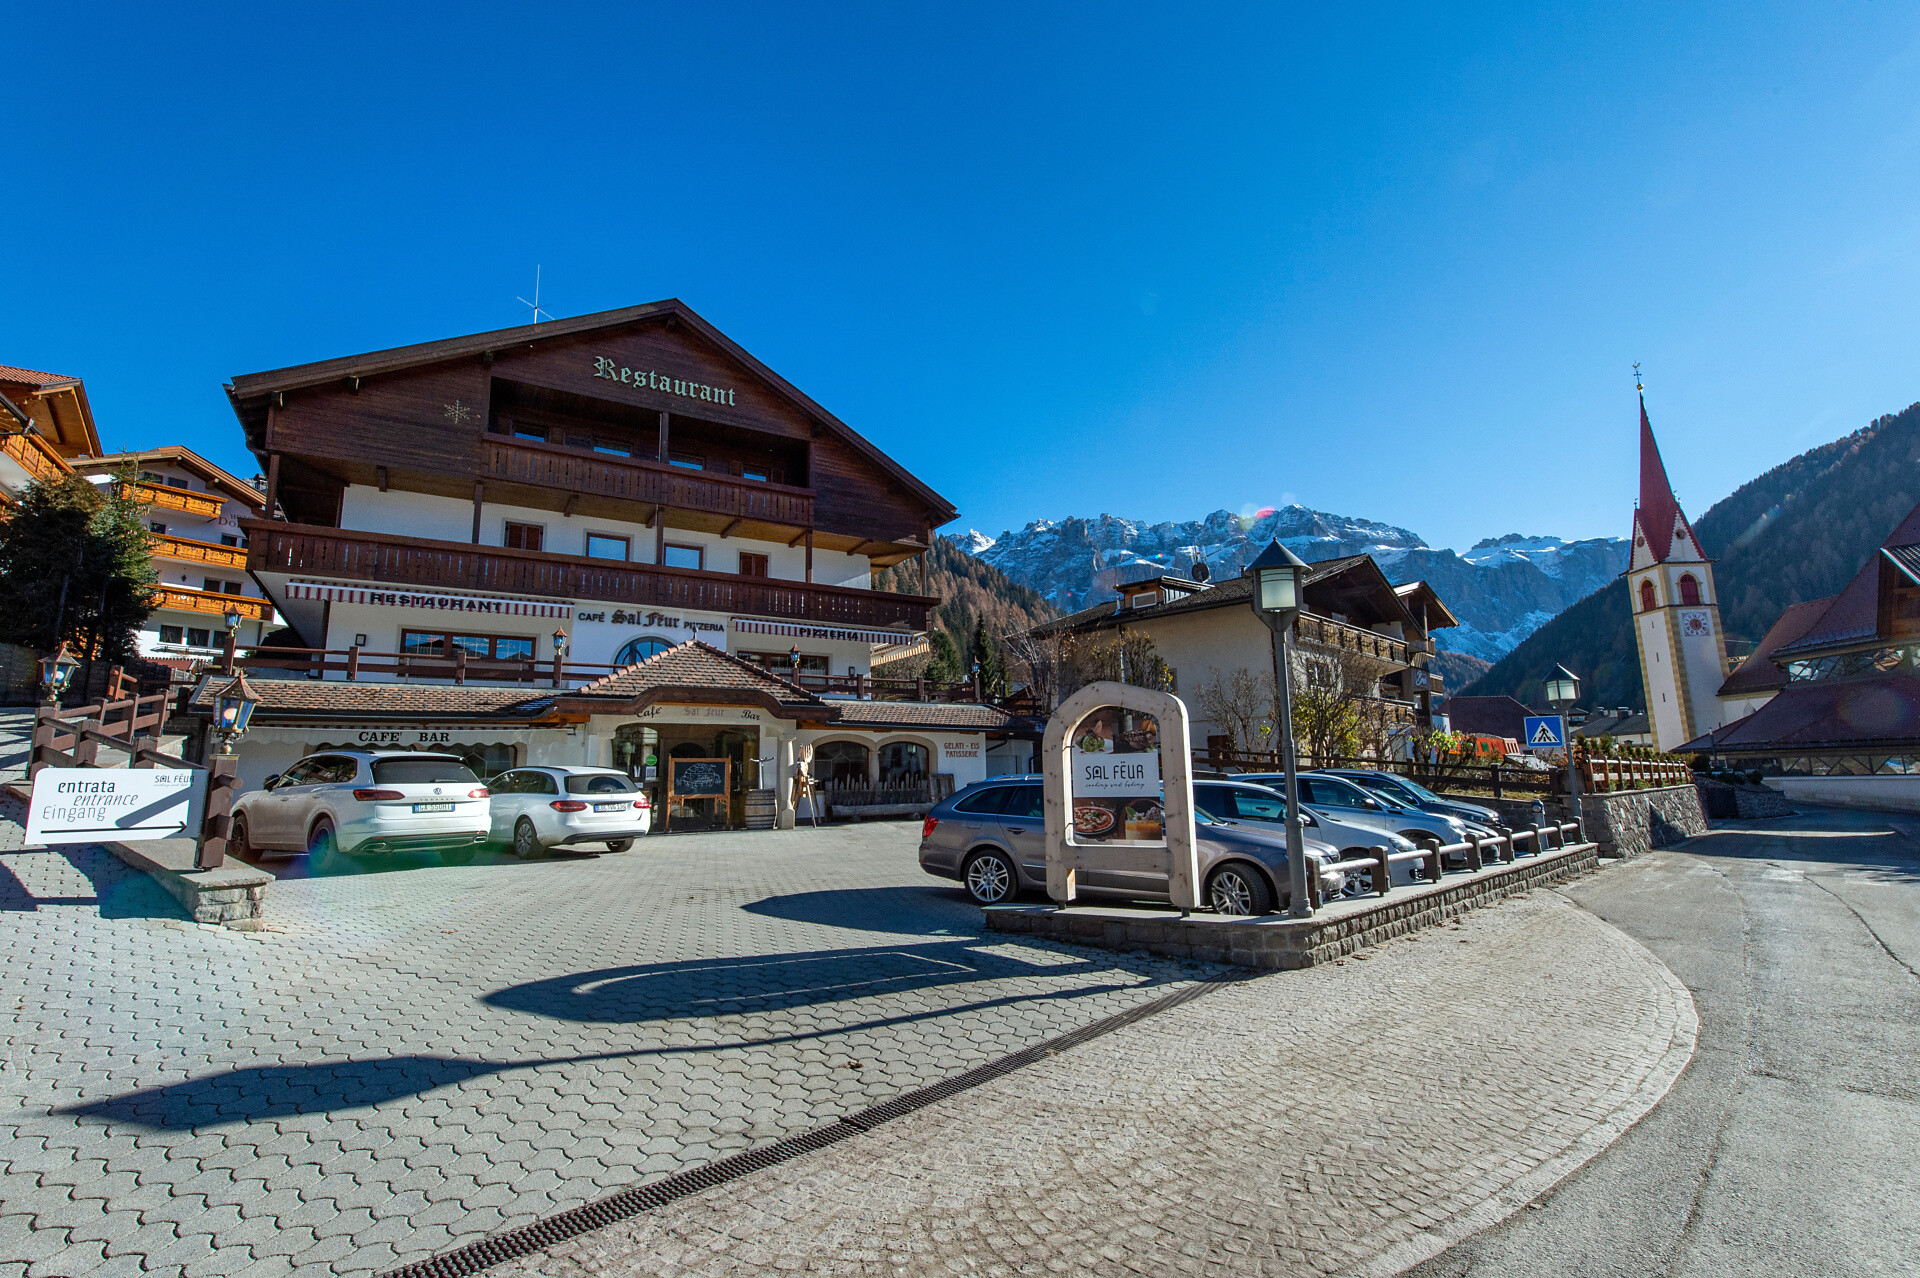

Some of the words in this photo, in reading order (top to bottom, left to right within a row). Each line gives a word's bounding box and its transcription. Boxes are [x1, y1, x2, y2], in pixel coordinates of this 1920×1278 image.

[593, 355, 736, 407] Restaurant
[370, 592, 502, 611] RESTAURANT
[611, 608, 642, 625] Sal
[799, 628, 859, 639] PIZZERIA
[741, 709, 760, 721] Bar
[418, 732, 450, 742] BAR
[944, 742, 965, 750] GELATI
[970, 742, 980, 750] EIS
[945, 750, 979, 758] PATISSERIE
[1085, 765, 1109, 780] SAL
[1113, 761, 1144, 780] FËUR
[154, 774, 171, 783] SAL
[57, 780, 116, 793] entrata
[73, 793, 139, 807] entrance
[42, 804, 107, 822] Eingang
